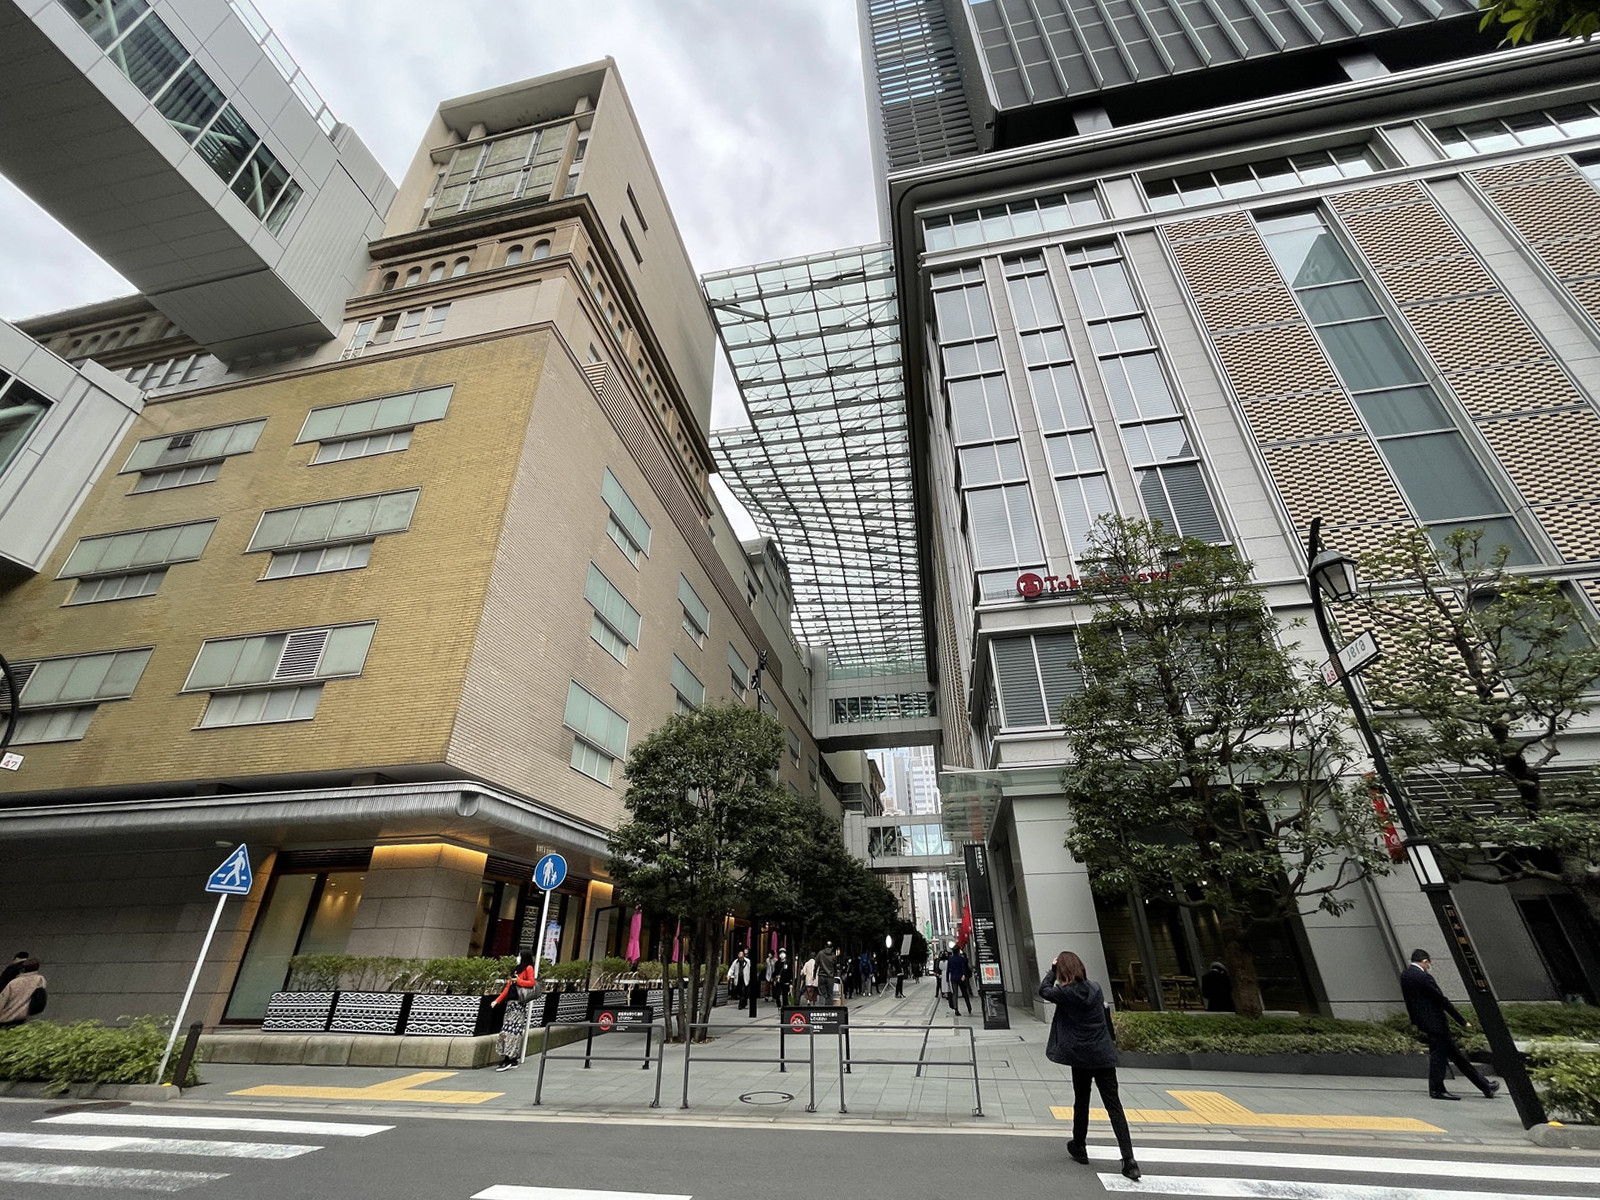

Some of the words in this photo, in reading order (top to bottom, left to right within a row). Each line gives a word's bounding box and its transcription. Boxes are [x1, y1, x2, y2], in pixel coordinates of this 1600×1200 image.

[1044, 569, 1170, 591] Takhaya
[1326, 669, 1337, 683] 48
[3, 760, 18, 768] 47
